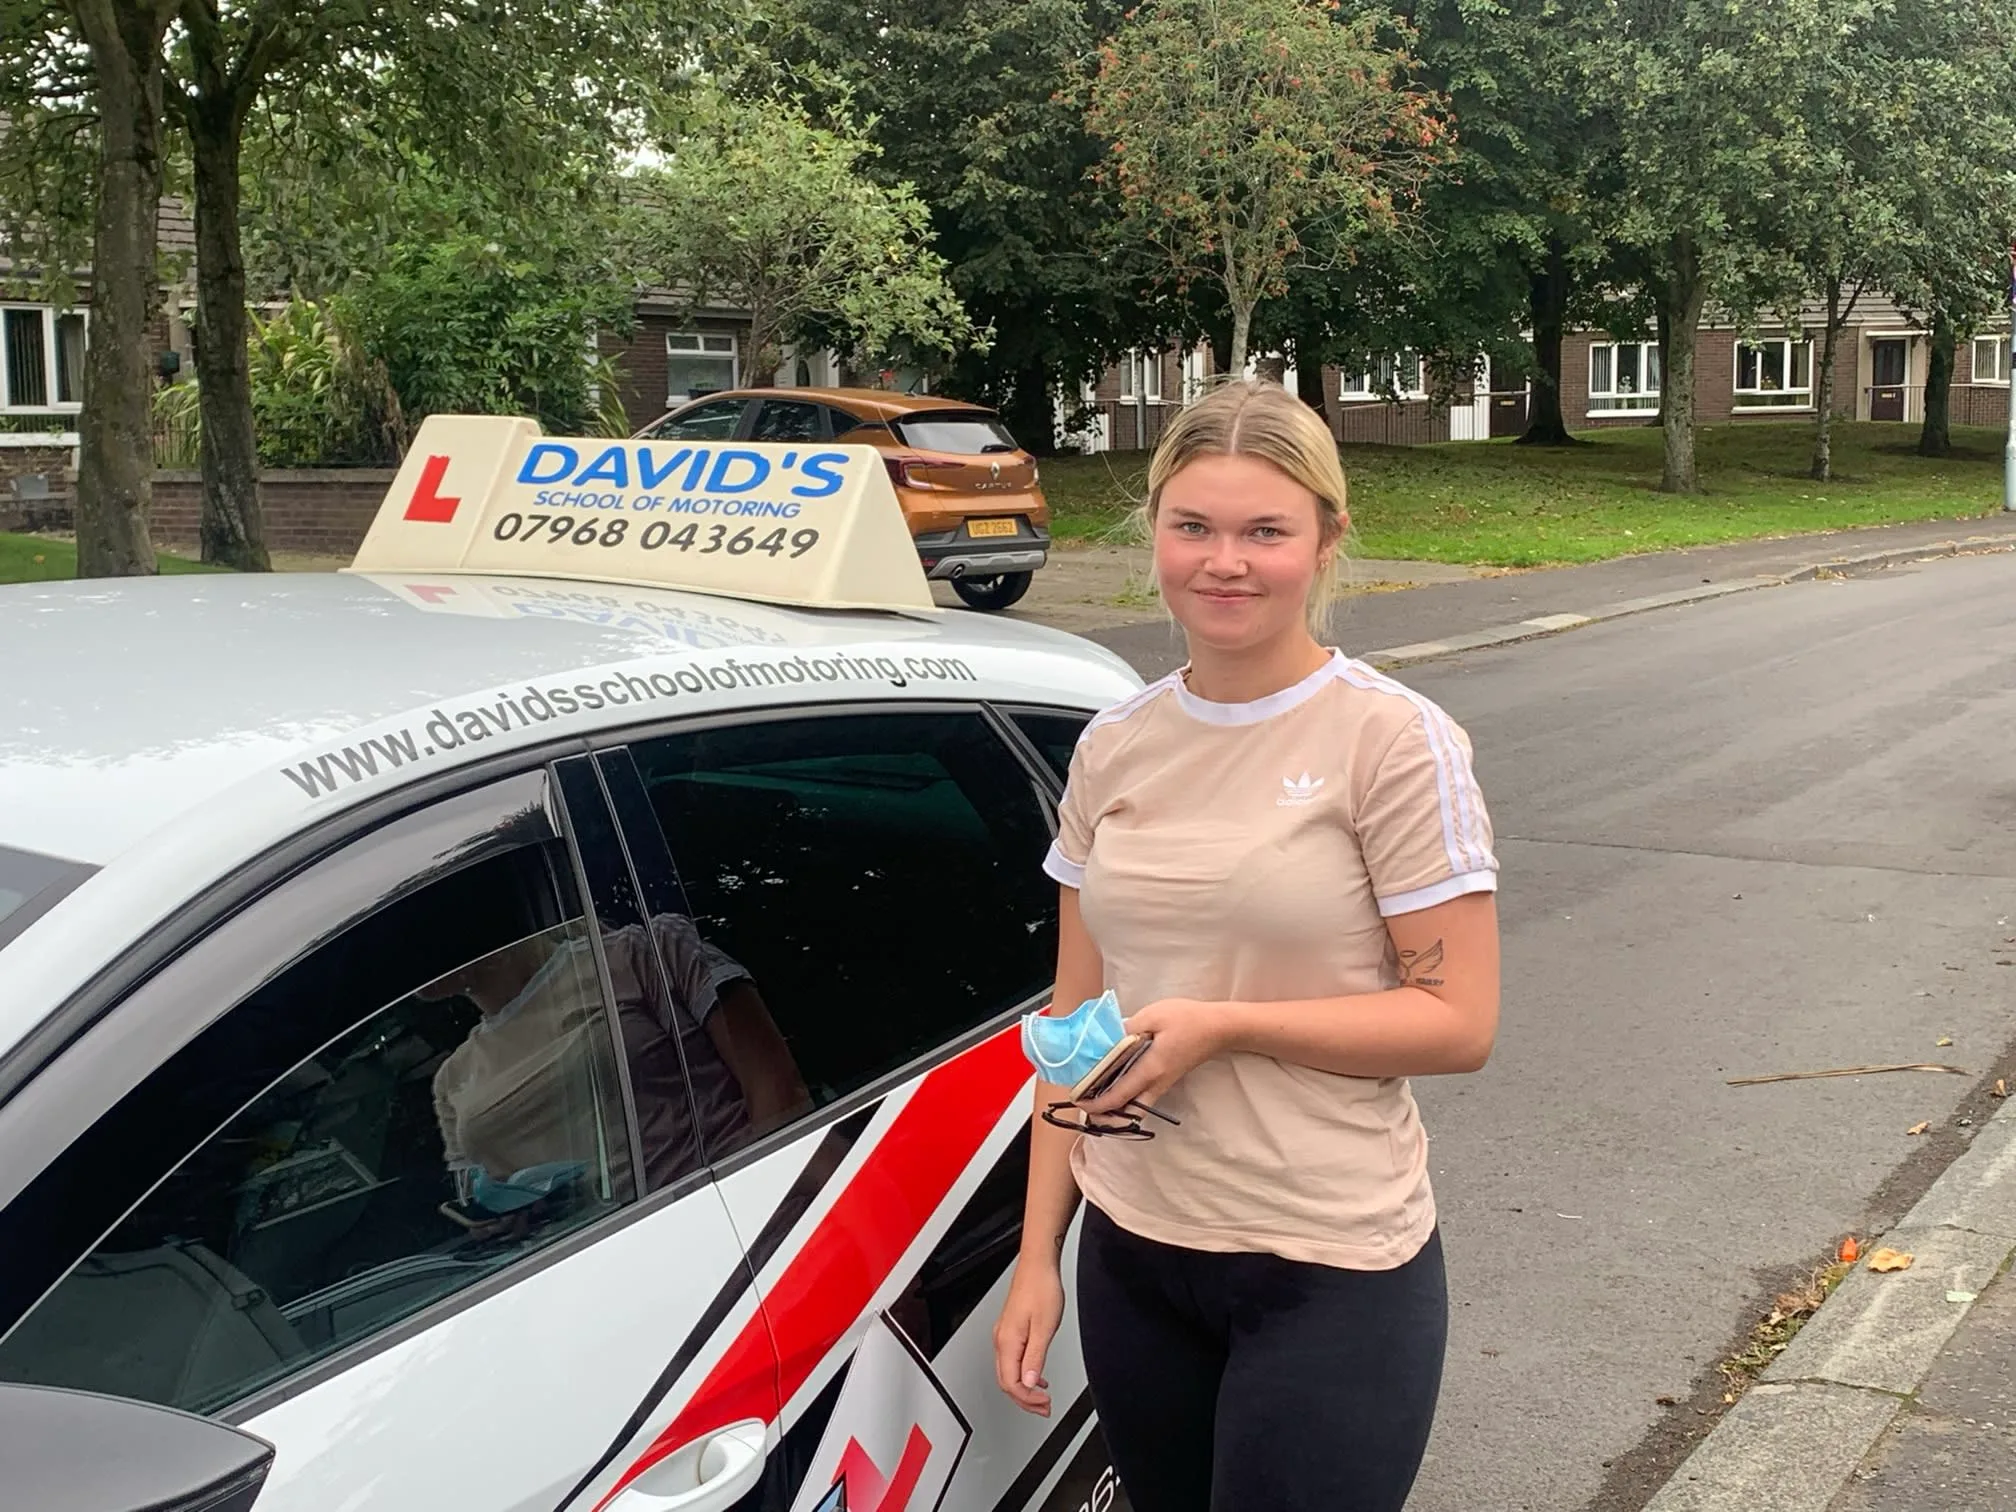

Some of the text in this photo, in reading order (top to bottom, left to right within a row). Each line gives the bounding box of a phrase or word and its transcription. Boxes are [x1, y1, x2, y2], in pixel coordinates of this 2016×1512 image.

[403, 455, 461, 523] L
[516, 443, 850, 498] DAVID'S
[533, 490, 802, 519] SCHOOL OF MOTORING
[494, 512, 820, 559] 07968 043649
[280, 652, 979, 799] www.davidsschoolofmotoring.com
